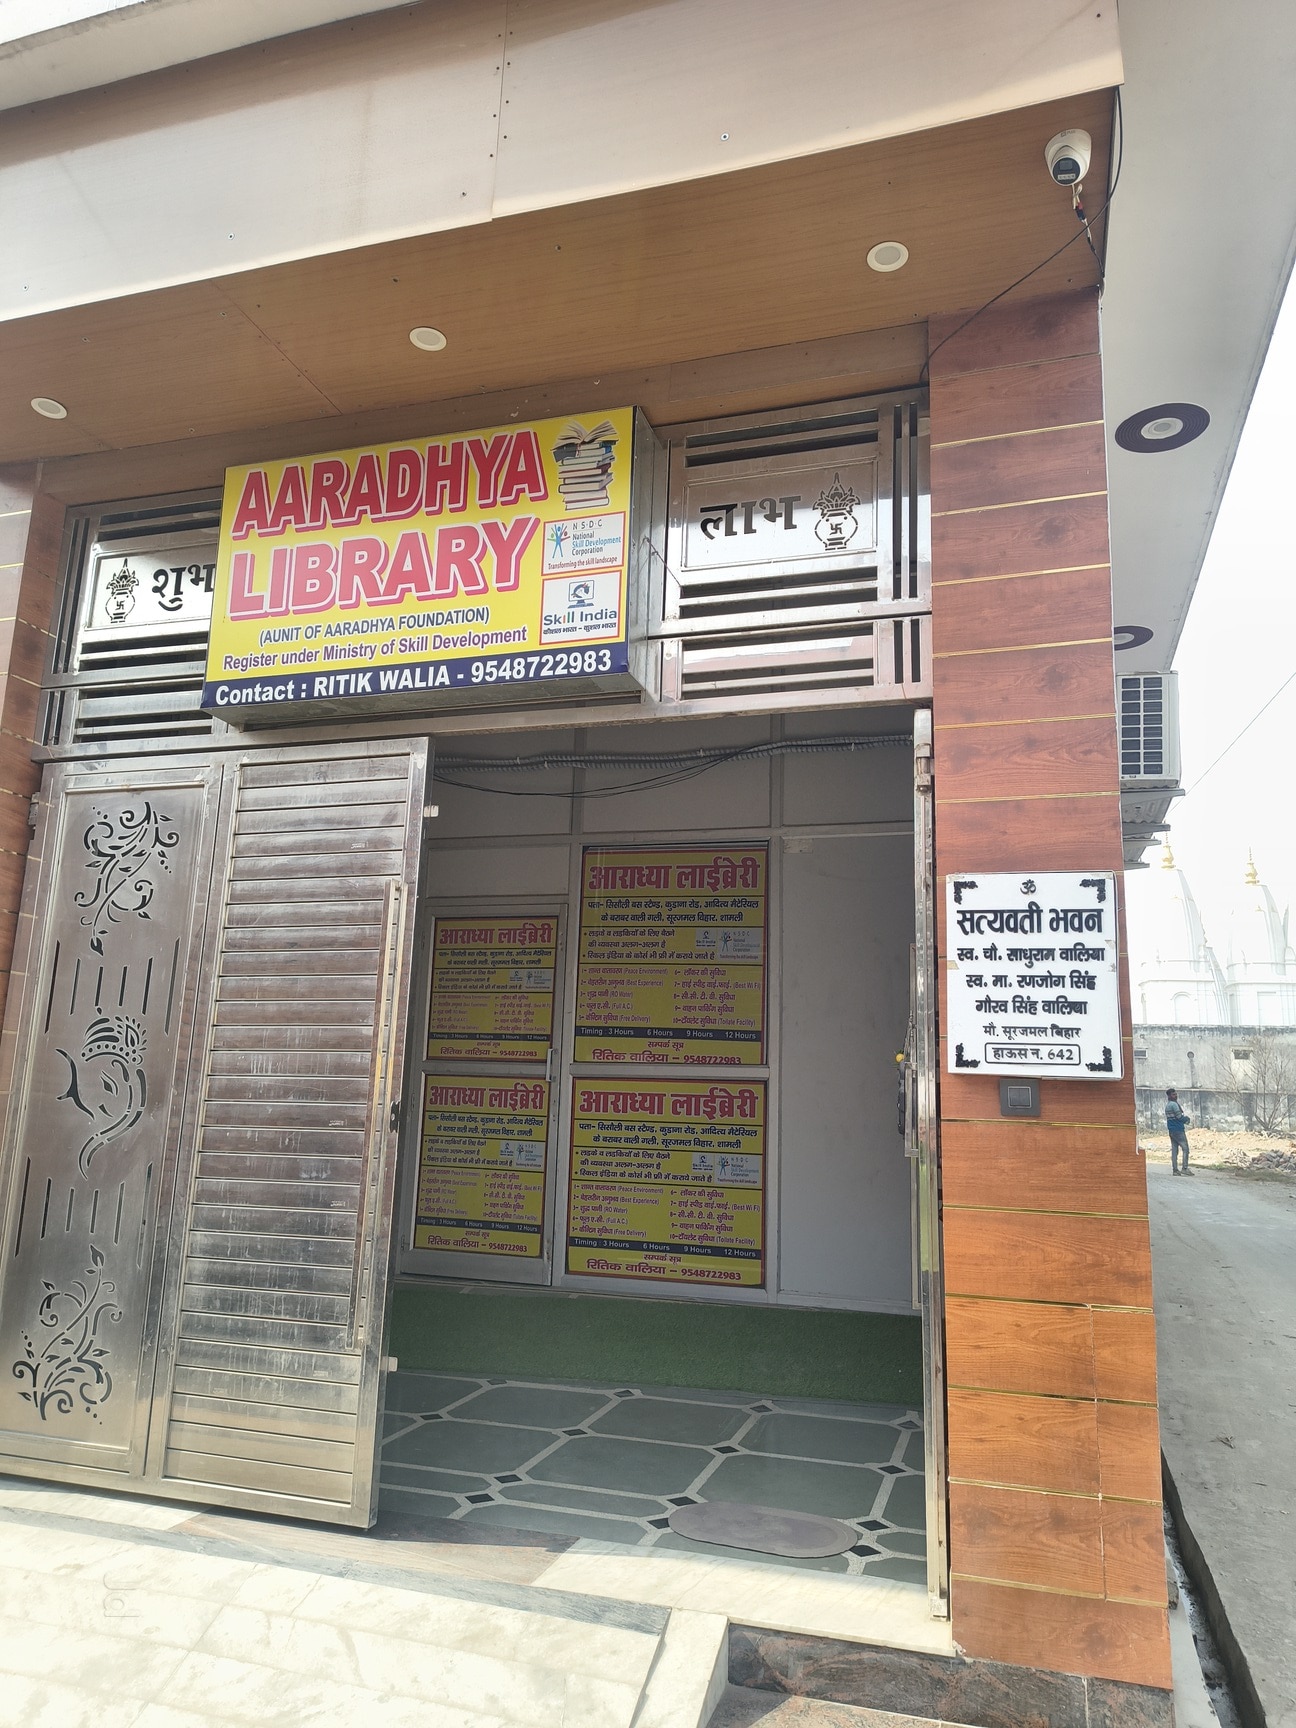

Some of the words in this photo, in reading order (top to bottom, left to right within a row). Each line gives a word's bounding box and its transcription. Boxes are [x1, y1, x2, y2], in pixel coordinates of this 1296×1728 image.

[230, 428, 548, 539] AARADHYA
[699, 495, 802, 540] लाभ
[572, 531, 594, 540] National
[572, 540, 584, 548] Skill
[585, 537, 621, 547] Development
[572, 546, 603, 556] Corporation
[228, 514, 540, 622] LIBRARY
[548, 560, 576, 570] Transforming
[586, 557, 594, 565] skill
[595, 556, 617, 565] landscape
[152, 563, 215, 611] शुभ
[304, 624, 322, 640] OF
[324, 617, 396, 638] AARADHYA
[399, 607, 490, 630] FOUNDATION)
[544, 612, 575, 626] Skill
[580, 609, 617, 622] India
[224, 650, 279, 671] Register
[281, 649, 319, 665] under
[323, 643, 377, 663] Ministry
[380, 639, 396, 655] of
[399, 635, 429, 653] Skill
[432, 627, 527, 651] Development
[216, 683, 294, 706] Contact
[313, 673, 373, 696] RITIK
[378, 666, 450, 690] WALIA
[471, 650, 611, 684] 9548722983
[589, 865, 672, 890] आराध्या
[676, 856, 760, 892] लाईब्रेरी
[957, 901, 1043, 935] सत्यवती
[1049, 908, 1103, 933] भवन
[440, 928, 495, 944] आराध्या
[957, 948, 979, 961] स्व.
[983, 943, 1002, 961] चौ.
[1007, 948, 1055, 968] साधुराम
[1060, 943, 1105, 961] वालिया
[966, 975, 987, 988] स्व.
[992, 975, 1012, 988] मा.
[1017, 971, 1065, 988] रणजोग
[1070, 970, 1096, 989] सिंह
[976, 995, 1008, 1014] गौरव
[1012, 995, 1038, 1015] सिंह
[1042, 996, 1088, 1015] वालिया
[581, 1027, 602, 1036] Timing
[692, 1030, 713, 1038] Hours
[983, 1022, 998, 1036] मौ.
[1002, 1026, 1048, 1040] सूरजमल
[592, 1049, 625, 1061] रितिक
[630, 1050, 668, 1062] वालिया
[684, 1055, 741, 1064] 9548722983
[992, 1047, 1028, 1060] हाऊस
[1030, 1050, 1043, 1059] न.
[1048, 1049, 1073, 1060] 642
[430, 1085, 486, 1107] आराध्या
[489, 1083, 545, 1111] लाईब्रेरी
[580, 1090, 666, 1115] आराध्या
[671, 1087, 758, 1120] लाईब्रेरी
[700, 1127, 725, 1135] आदित्य
[489, 1243, 527, 1252] 9548722983
[575, 1238, 597, 1247] Timing
[649, 1243, 670, 1251] Hours
[734, 1249, 756, 1257] Hours
[587, 1259, 622, 1271] रितिक
[626, 1261, 666, 1274] वालिया
[681, 1269, 741, 1280] 9548722983
